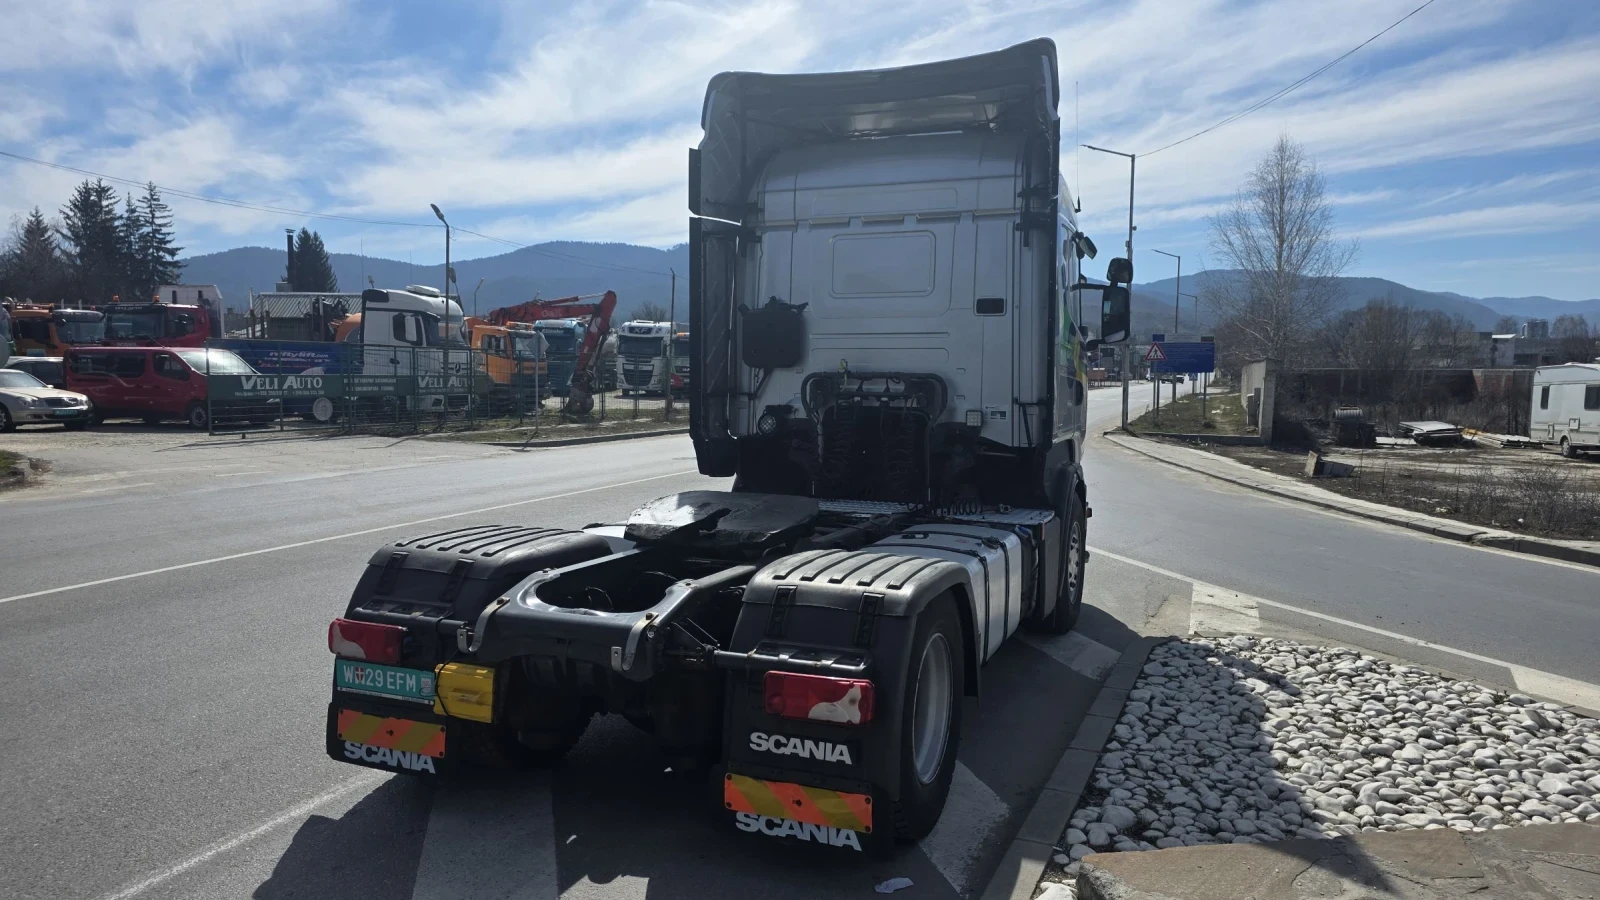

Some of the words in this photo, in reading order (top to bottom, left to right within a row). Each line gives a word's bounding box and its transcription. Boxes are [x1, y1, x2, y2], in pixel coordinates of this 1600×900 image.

[240, 376, 279, 390] VELI
[282, 376, 323, 390] AUTO
[343, 740, 436, 774] SCANIA
[750, 732, 853, 765] SCANIA
[735, 811, 863, 852] SCANIA
